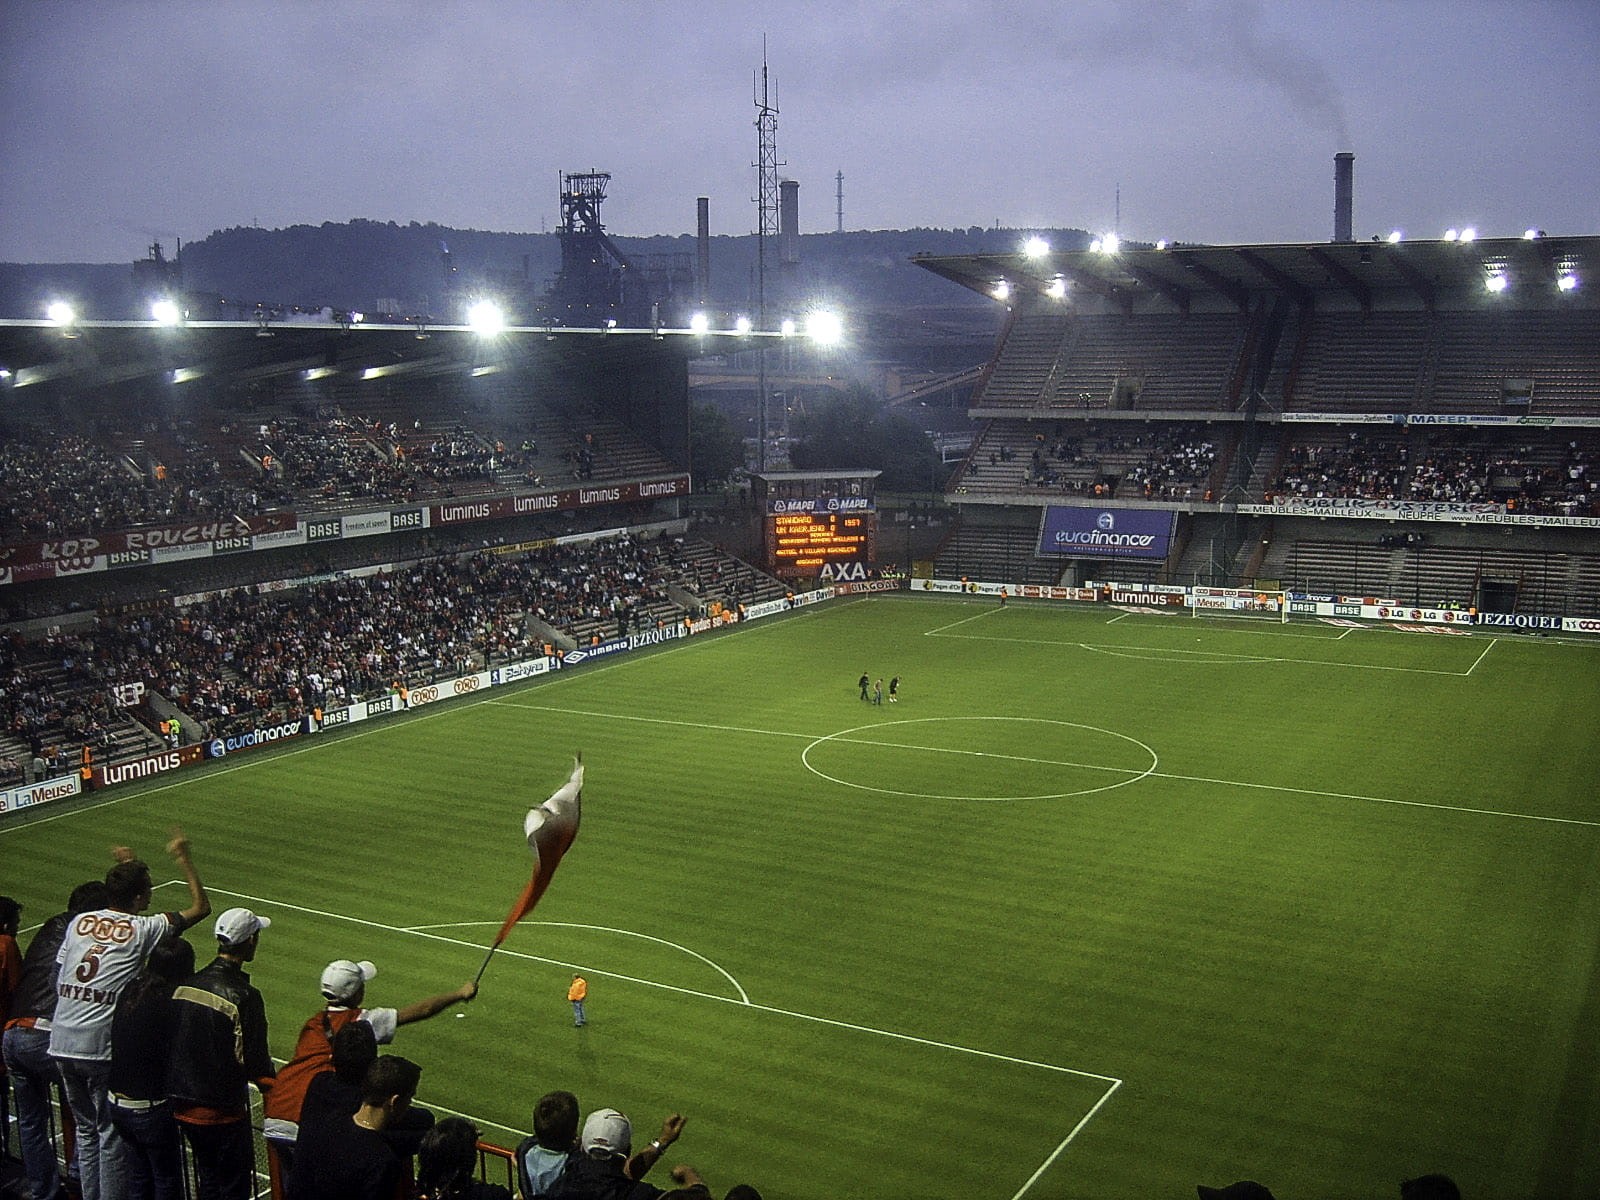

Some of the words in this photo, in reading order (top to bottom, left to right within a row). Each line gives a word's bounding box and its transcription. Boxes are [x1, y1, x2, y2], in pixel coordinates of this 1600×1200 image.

[1411, 415, 1468, 424] MAFER
[579, 487, 620, 504] luminus
[639, 481, 676, 497] luminus
[513, 494, 558, 512] luminus
[787, 500, 815, 510] MAPEI
[840, 499, 868, 509] MAPEI
[393, 513, 421, 528] BASE
[440, 503, 490, 522] luminus
[309, 522, 340, 538] BASE
[41, 538, 100, 560] KOP
[126, 522, 250, 550] ROUCHES
[820, 562, 866, 580] AXA
[1111, 589, 1167, 606] luminus
[1291, 603, 1316, 612] BASE
[1335, 606, 1360, 614] BASE
[1456, 613, 1469, 621] LG
[1475, 612, 1560, 629] JEZEQUEL
[627, 626, 677, 650] JEZEQUEL
[454, 676, 479, 693] TNT
[412, 687, 438, 705] TNT
[368, 700, 391, 715] BASE
[323, 711, 348, 726] BASE
[102, 752, 181, 785] luminus
[15, 782, 74, 807] LaMeuse
[78, 916, 133, 943] TNT
[76, 944, 108, 983] 5
